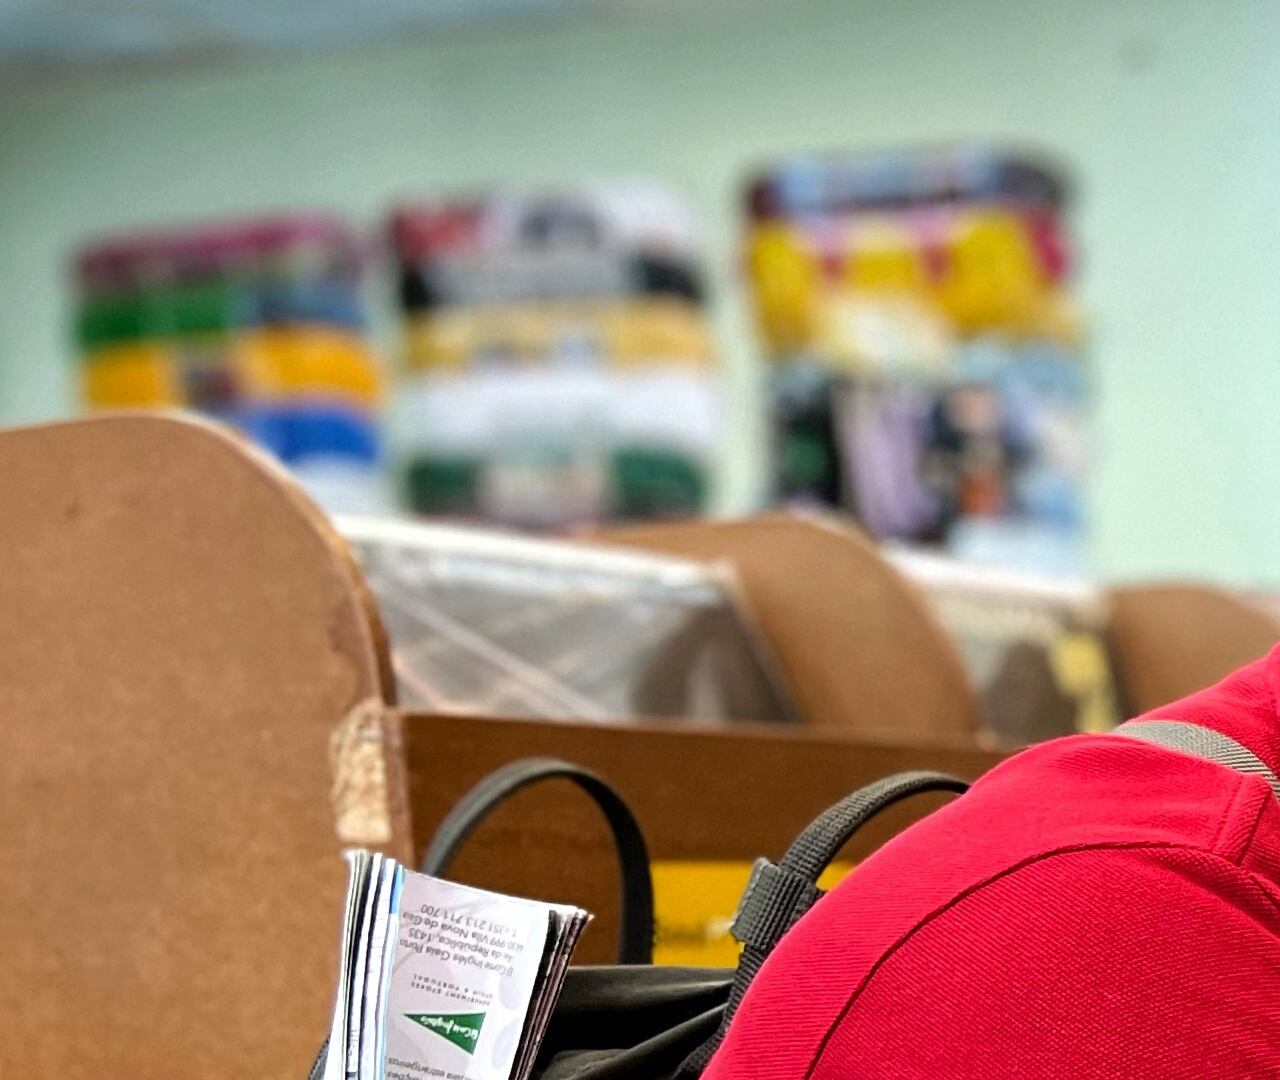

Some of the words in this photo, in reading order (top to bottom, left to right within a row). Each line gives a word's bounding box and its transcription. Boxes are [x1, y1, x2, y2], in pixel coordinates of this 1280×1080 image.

[420, 904, 441, 918] 700
[443, 910, 464, 924] 711
[424, 918, 438, 929] de
[466, 916, 487, 930] 213
[409, 928, 432, 942] 1435
[441, 923, 469, 939] Nova
[471, 932, 488, 943] Vila
[426, 946, 450, 961] Gaia
[491, 950, 502, 959] da
